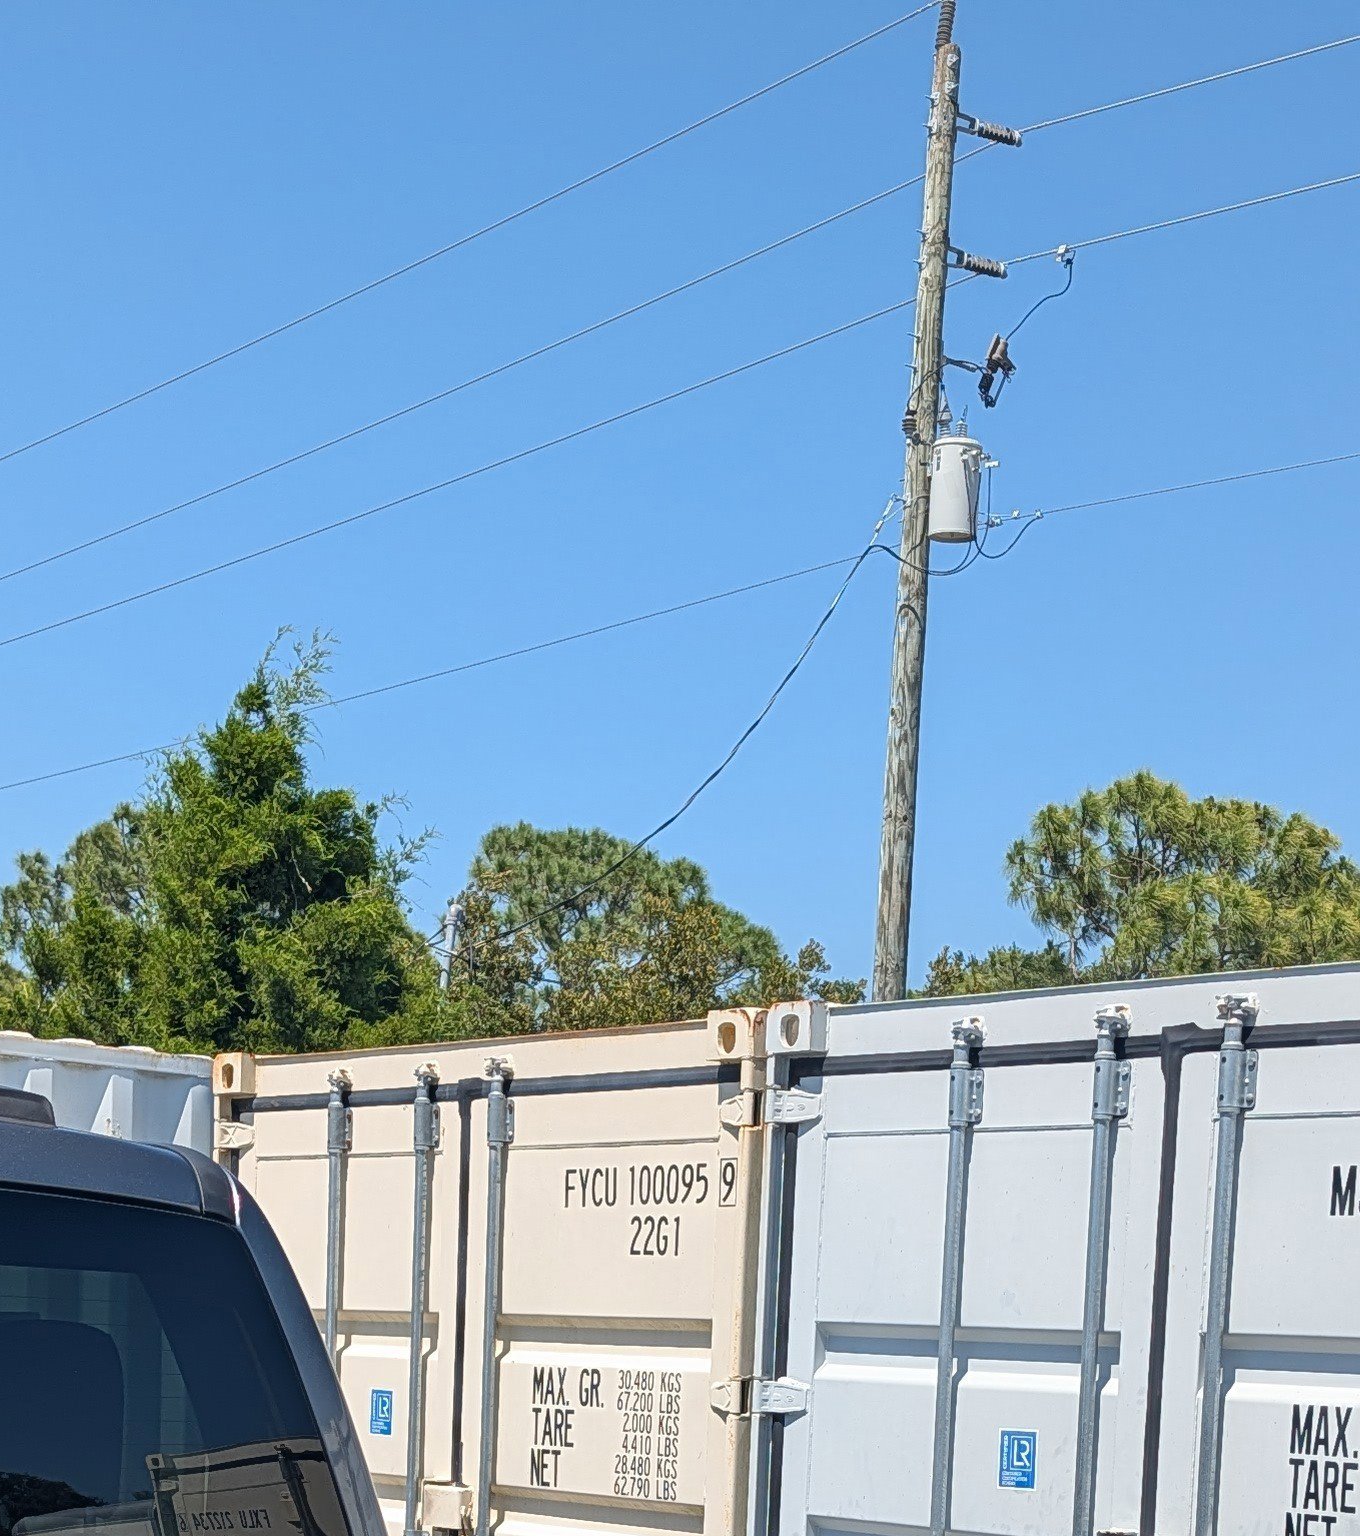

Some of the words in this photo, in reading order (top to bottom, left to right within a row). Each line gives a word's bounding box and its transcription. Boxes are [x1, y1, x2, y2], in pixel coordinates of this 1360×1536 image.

[564, 1167, 617, 1208] FYCU
[629, 1163, 709, 1206] 100095
[629, 1215, 680, 1256] 22G1
[532, 1366, 570, 1407] MAX.
[578, 1368, 604, 1409] GR.
[617, 1369, 655, 1391] 30,480
[660, 1371, 682, 1393] KGS
[659, 1393, 681, 1415] LBS
[531, 1407, 575, 1448] TARE
[658, 1415, 680, 1437] KGS
[621, 1433, 652, 1456] 4,410
[657, 1436, 679, 1458] LBS
[530, 1447, 561, 1488] NET
[656, 1458, 678, 1480] KGS
[656, 1479, 677, 1501] LBS
[1288, 1457, 1359, 1515] TARE
